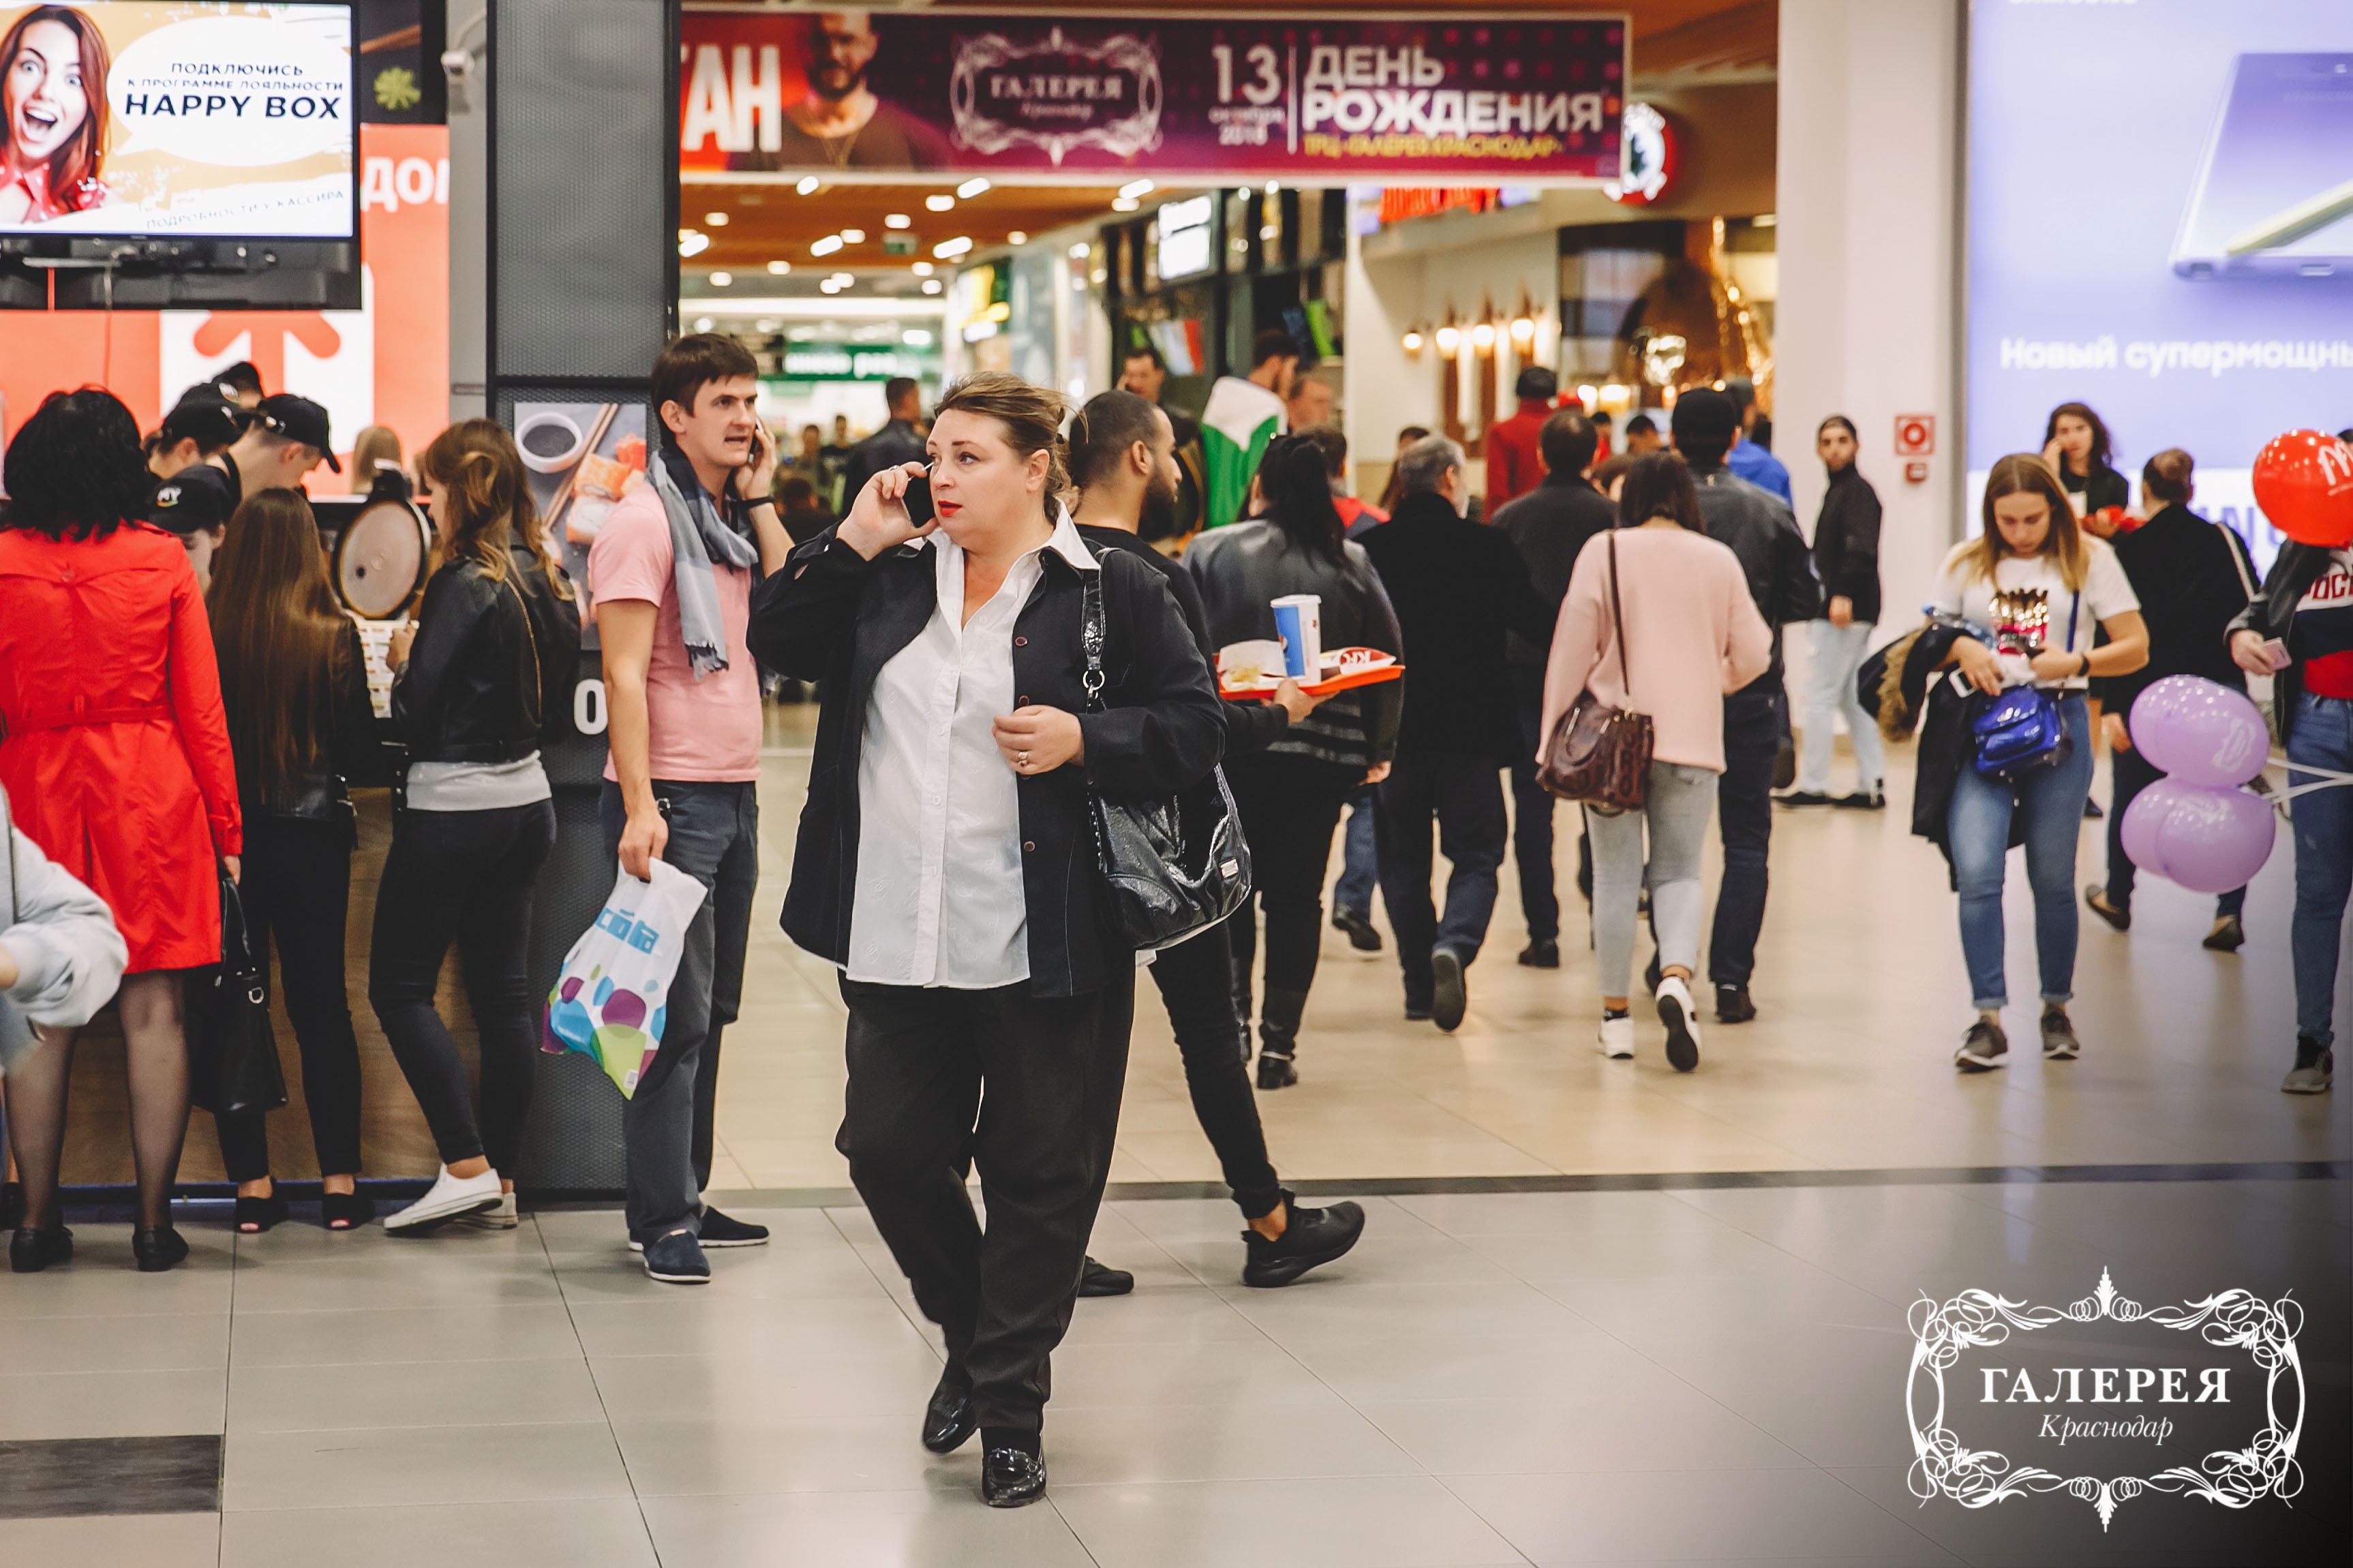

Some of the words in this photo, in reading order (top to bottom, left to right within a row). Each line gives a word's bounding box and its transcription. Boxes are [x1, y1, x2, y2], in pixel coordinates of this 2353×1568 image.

[170, 63, 303, 76] ПОДКЛЮЧИСЬ
[1211, 44, 1281, 104] 13
[1303, 46, 1445, 89] ДЕНЬ
[127, 78, 135, 87] К
[141, 79, 233, 89] ПРОГРАММЕ
[239, 80, 343, 91] ЛОЯЛЬНОСТИ
[990, 74, 1123, 99] ГАЛЕРЕЯ
[125, 93, 250, 117] HAPPY
[265, 96, 339, 119] BOX
[1302, 91, 1604, 139] РОЖДЕНИЯ
[2001, 335, 2117, 368] Новый
